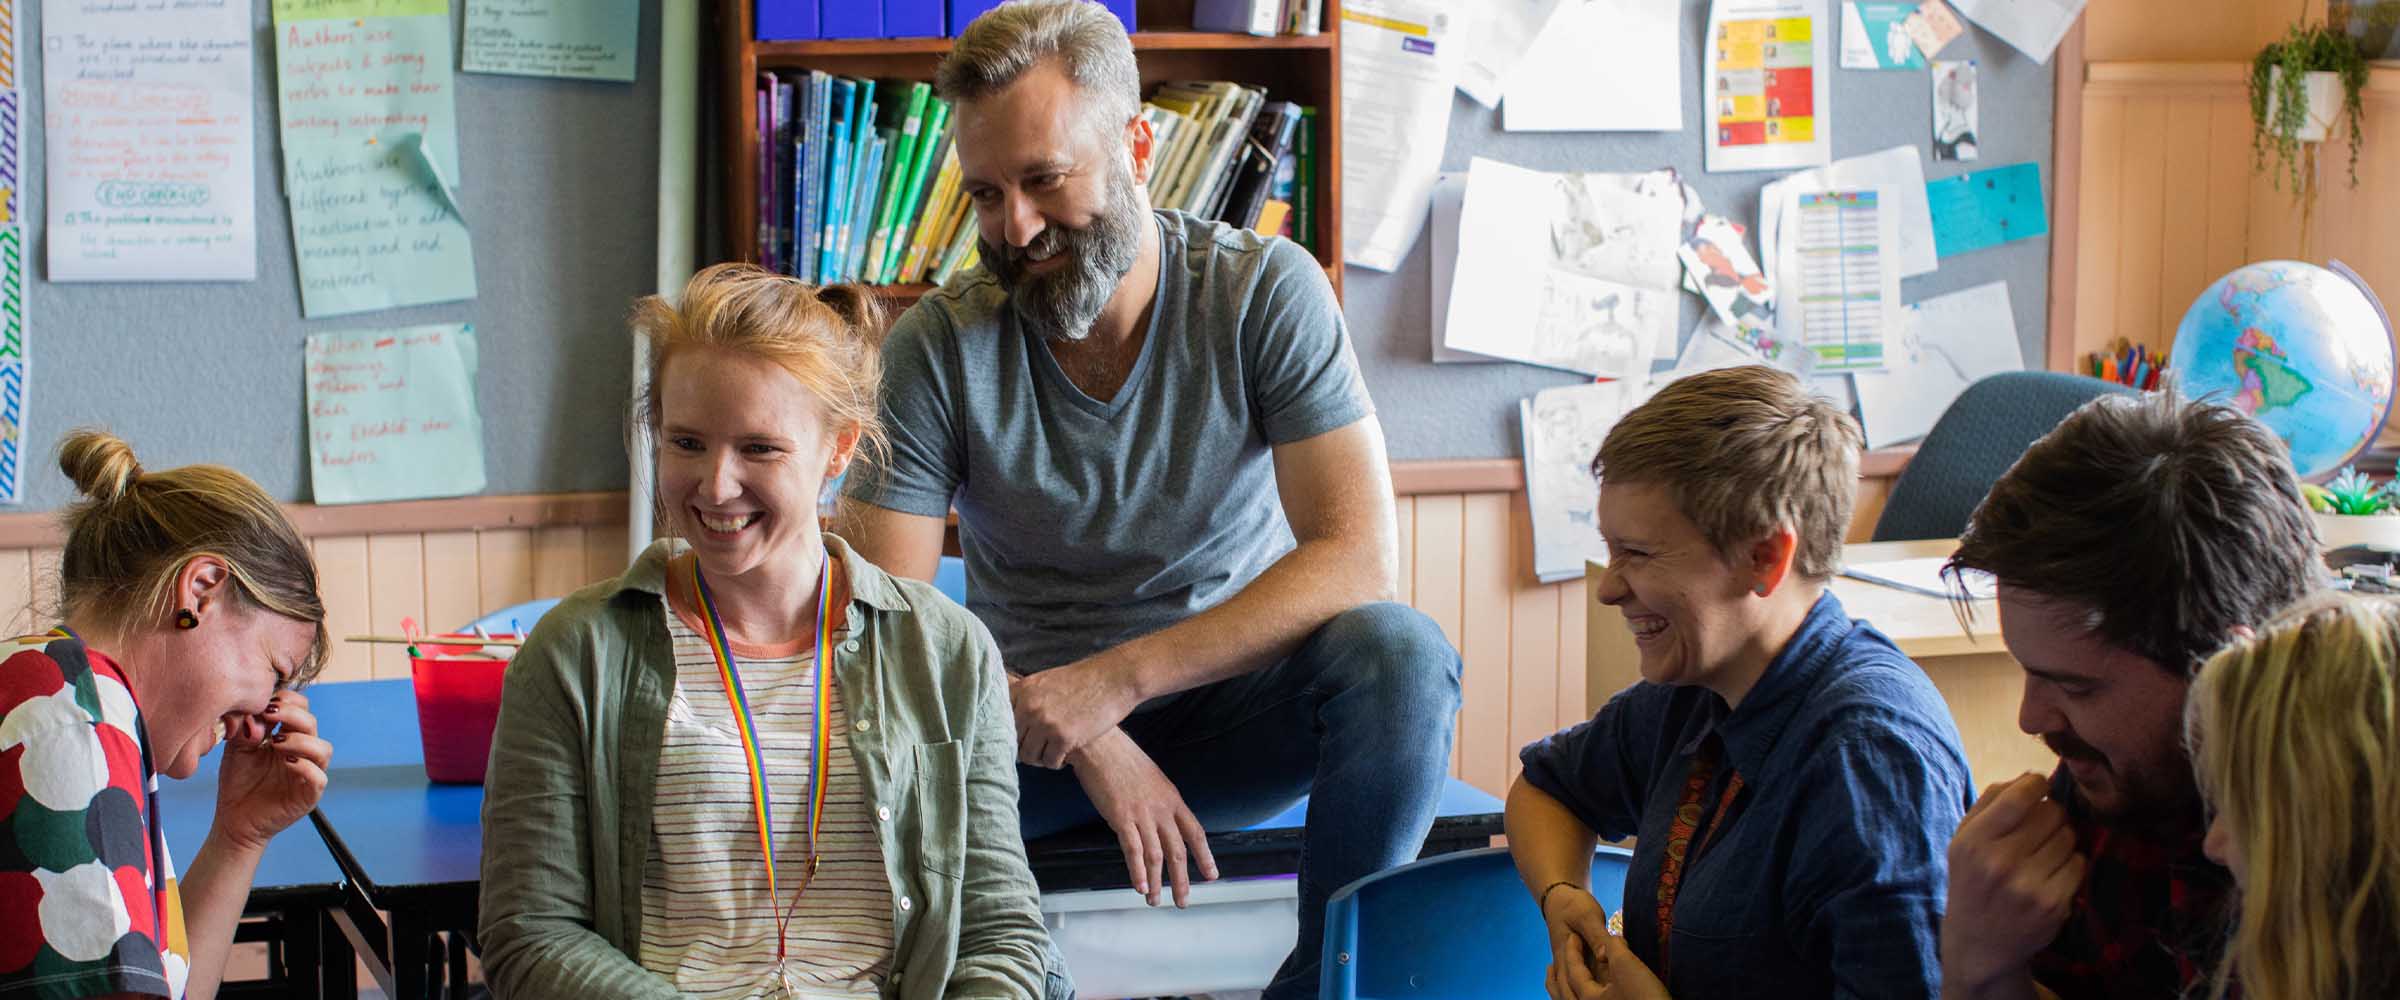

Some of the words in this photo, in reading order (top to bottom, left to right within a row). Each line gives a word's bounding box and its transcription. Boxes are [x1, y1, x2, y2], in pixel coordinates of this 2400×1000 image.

[288, 24, 353, 49] Authors
[382, 50, 425, 74] strong
[338, 81, 355, 97] to
[365, 80, 400, 97] make
[287, 113, 340, 138] writing
[295, 156, 365, 183] Authors
[368, 235, 399, 255] and
